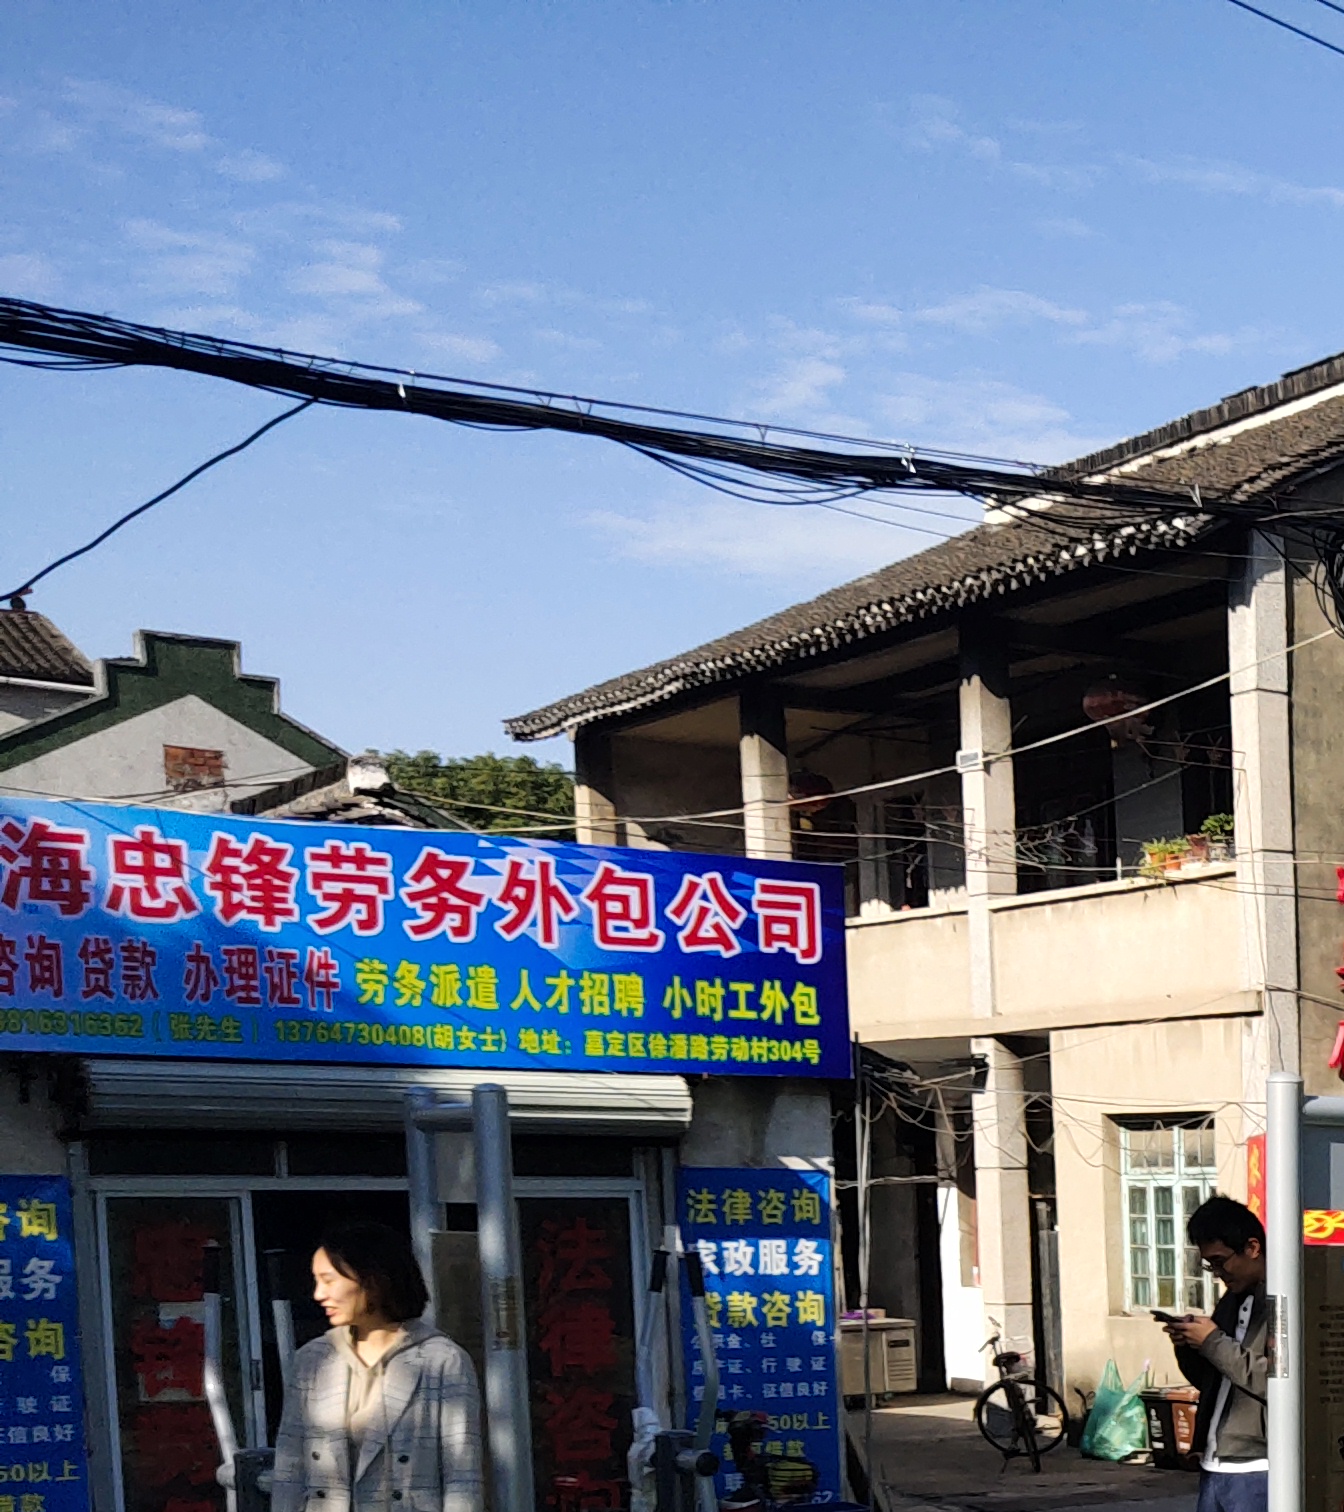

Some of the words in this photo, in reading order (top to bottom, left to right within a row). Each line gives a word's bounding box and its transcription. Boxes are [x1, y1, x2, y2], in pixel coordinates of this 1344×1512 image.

[0, 820, 821, 963] 海忠锋劳务外包公司
[77, 936, 160, 1001] 贷款
[183, 941, 342, 1012] 办理证件
[355, 957, 499, 1011] 劳务派遣
[510, 967, 645, 1019] 人才招聘
[662, 975, 821, 1026] 小时工外包
[0, 1198, 59, 1241] 询
[686, 1188, 822, 1226] 法律咨询
[690, 1238, 823, 1276] 家政服务
